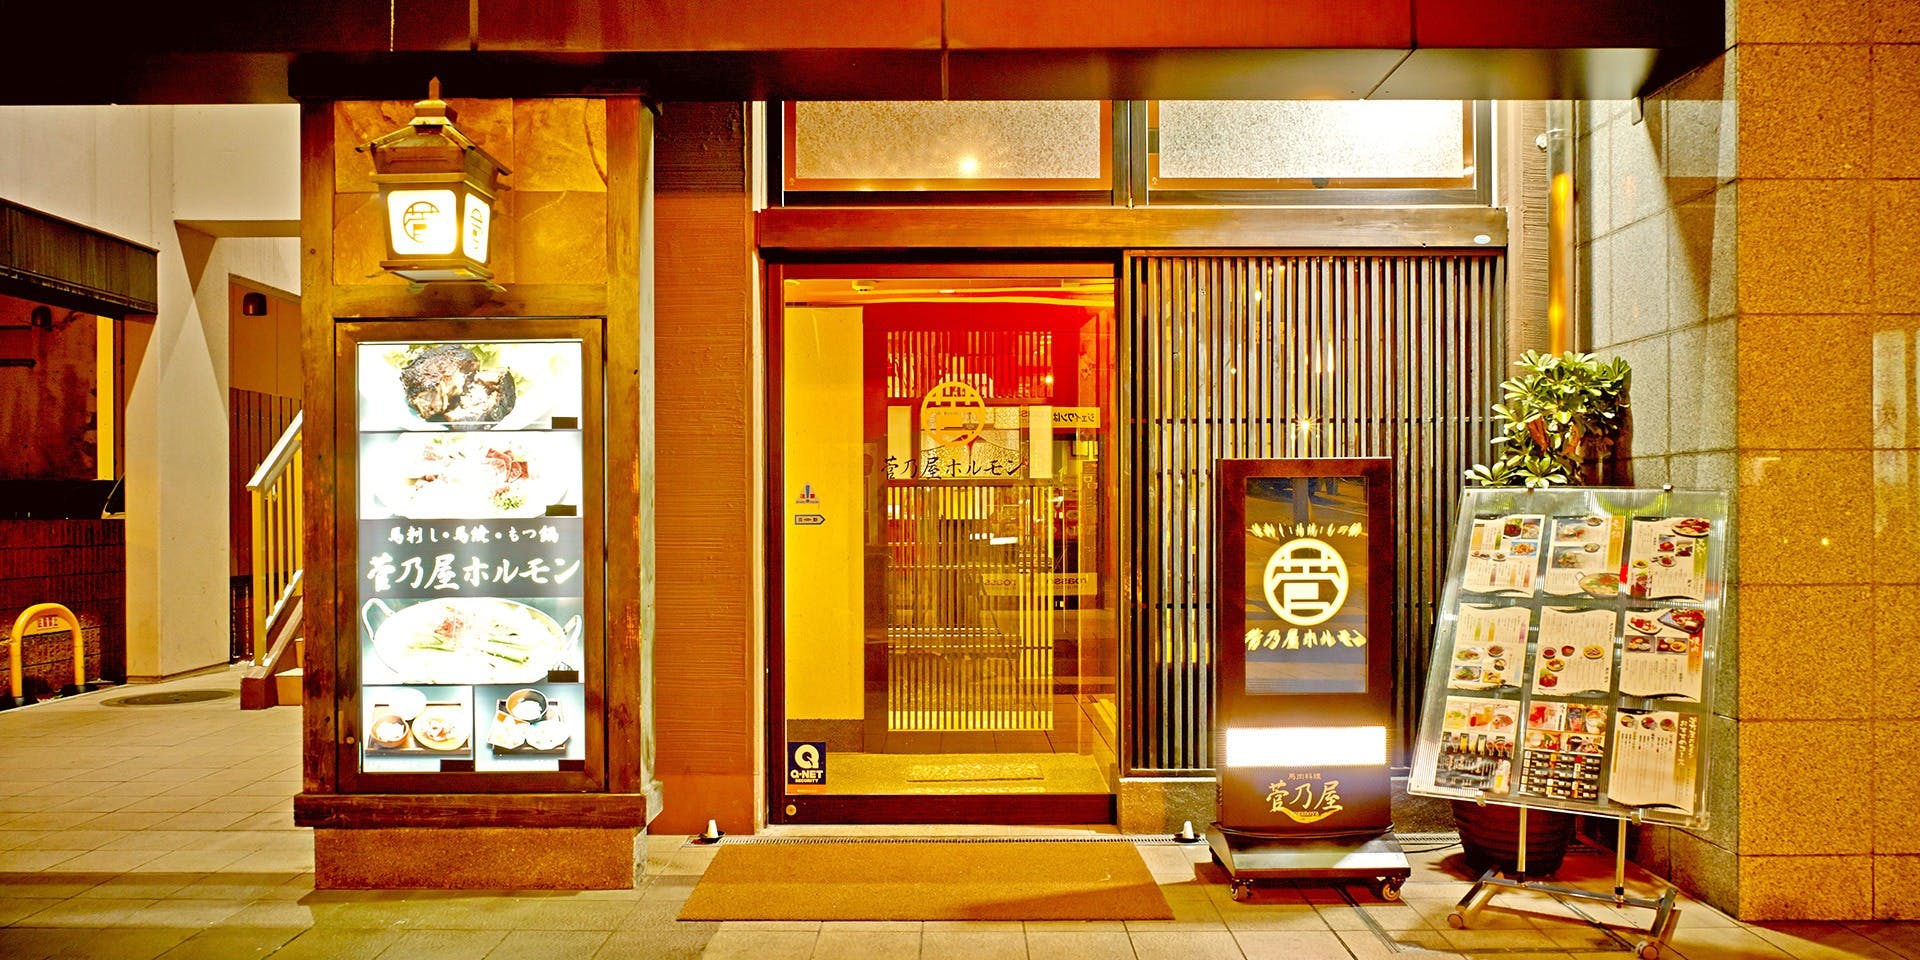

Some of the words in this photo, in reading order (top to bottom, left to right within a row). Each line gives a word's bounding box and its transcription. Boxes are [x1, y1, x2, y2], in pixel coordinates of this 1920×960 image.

[881, 455, 1024, 480] 菅乃屋ホルモン
[366, 552, 581, 593] 菅乃屋ホルモン
[1265, 779, 1343, 812] 菅乃屋
